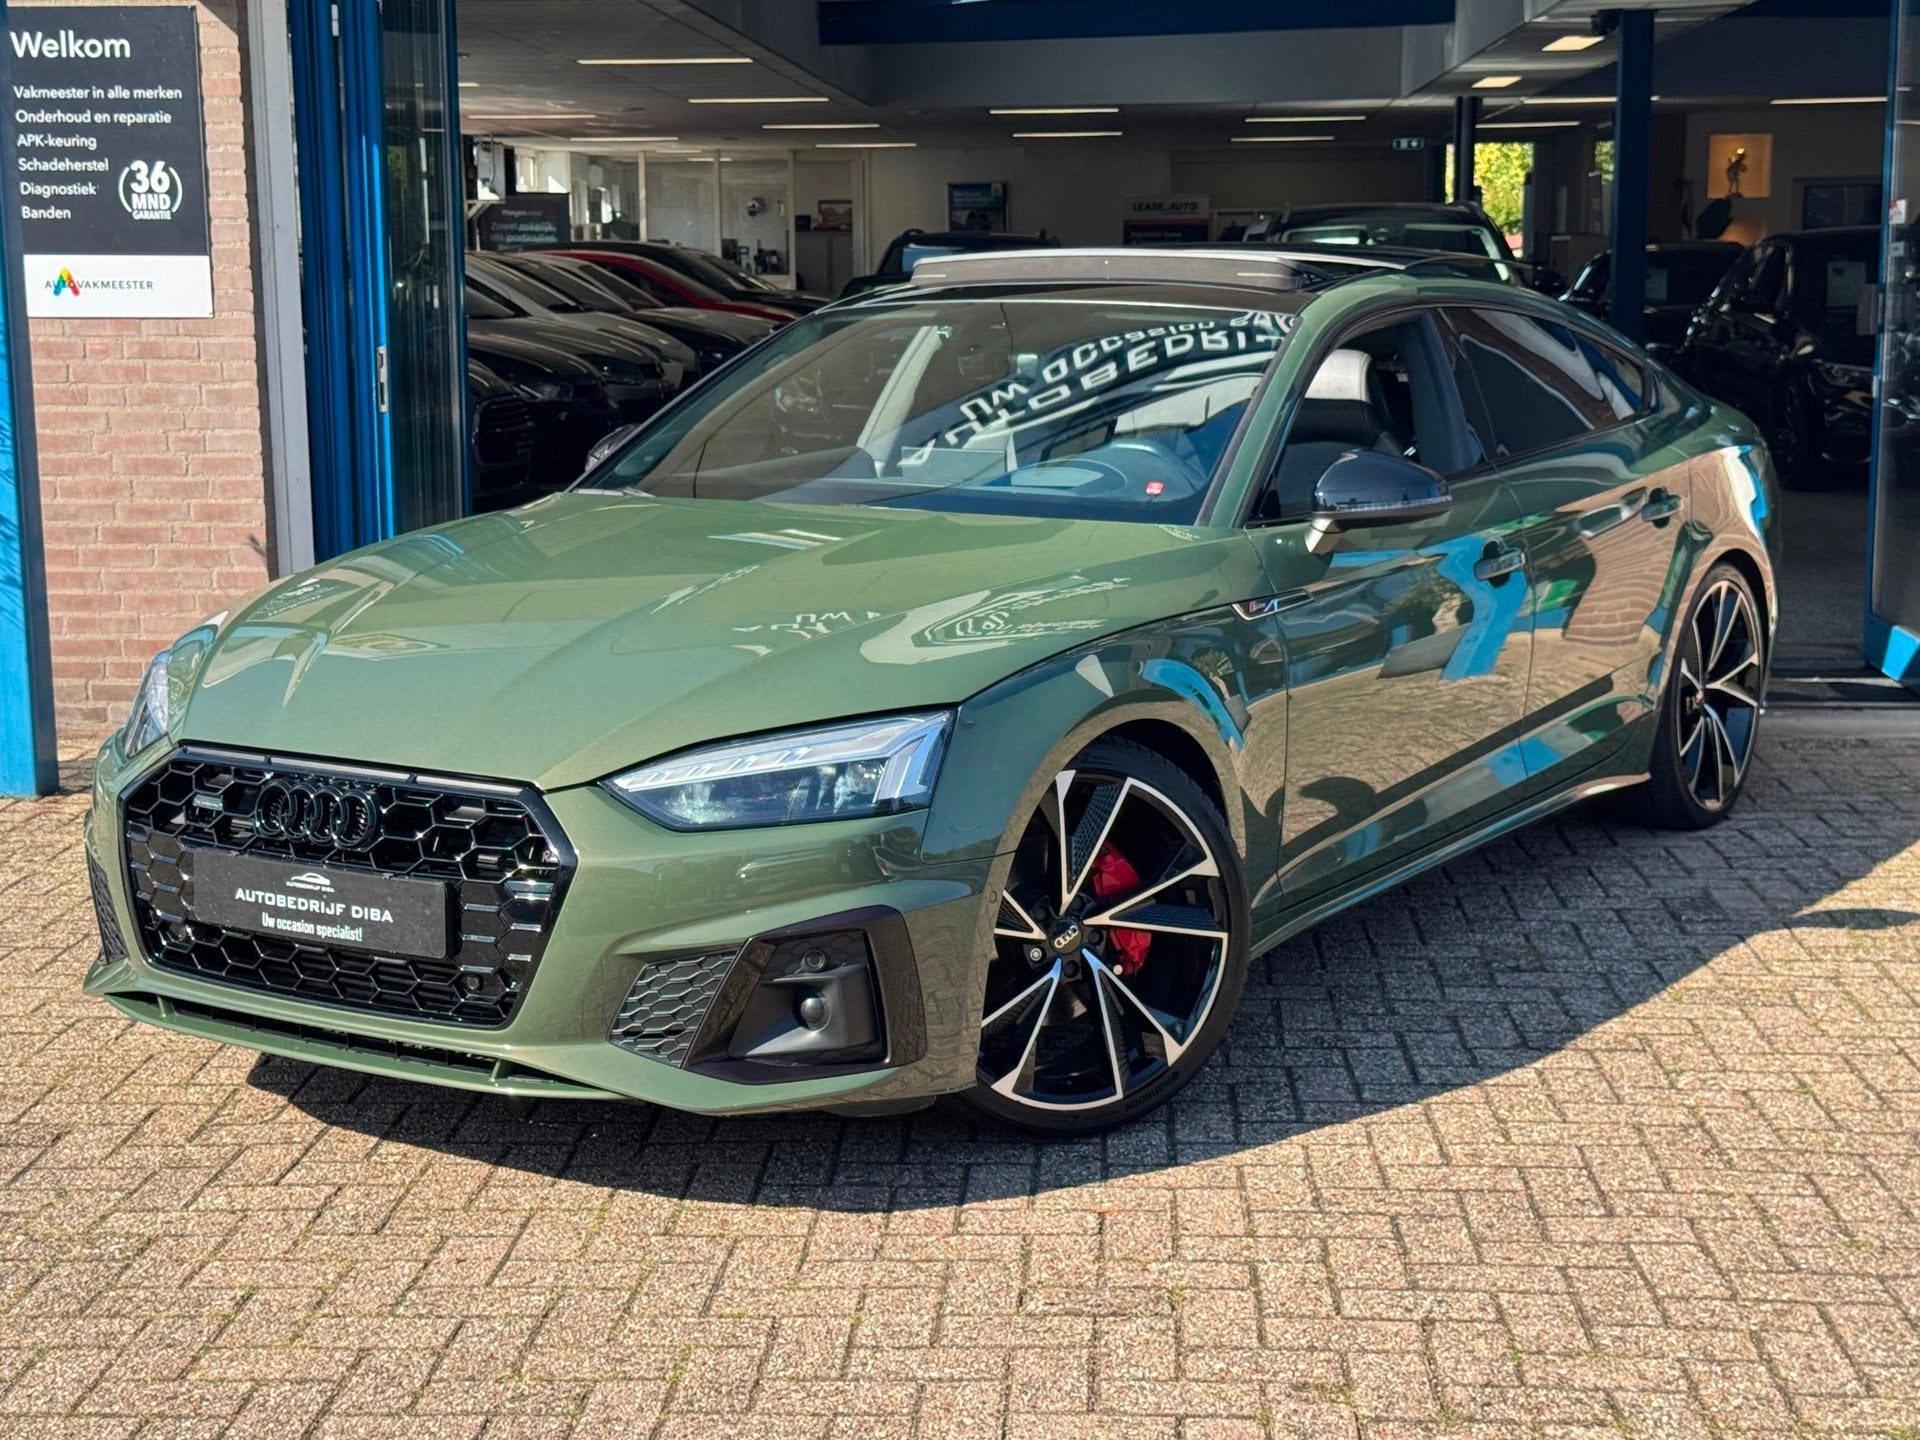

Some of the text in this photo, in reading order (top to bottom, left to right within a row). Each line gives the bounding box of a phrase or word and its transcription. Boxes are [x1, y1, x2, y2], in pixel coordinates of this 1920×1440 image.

[9, 29, 131, 58] Welkom
[13, 85, 182, 99] Vakmeester in alle merken
[15, 109, 172, 126] Onderhoud en reparatie
[17, 134, 97, 150] APK-keuring
[18, 157, 109, 171] Schadeherstel
[130, 160, 170, 193] 36
[20, 181, 97, 198] Diagnostiek
[131, 193, 171, 210] MND
[1132, 202, 1164, 211] LEASE
[21, 205, 71, 219] Banden
[132, 210, 172, 220] GARANTIE
[45, 280, 154, 290] AUTOVAKMEESTER
[235, 888, 394, 923] AUTOBEDRIJF DIBA
[262, 912, 362, 942] Uw occasion specialist!
